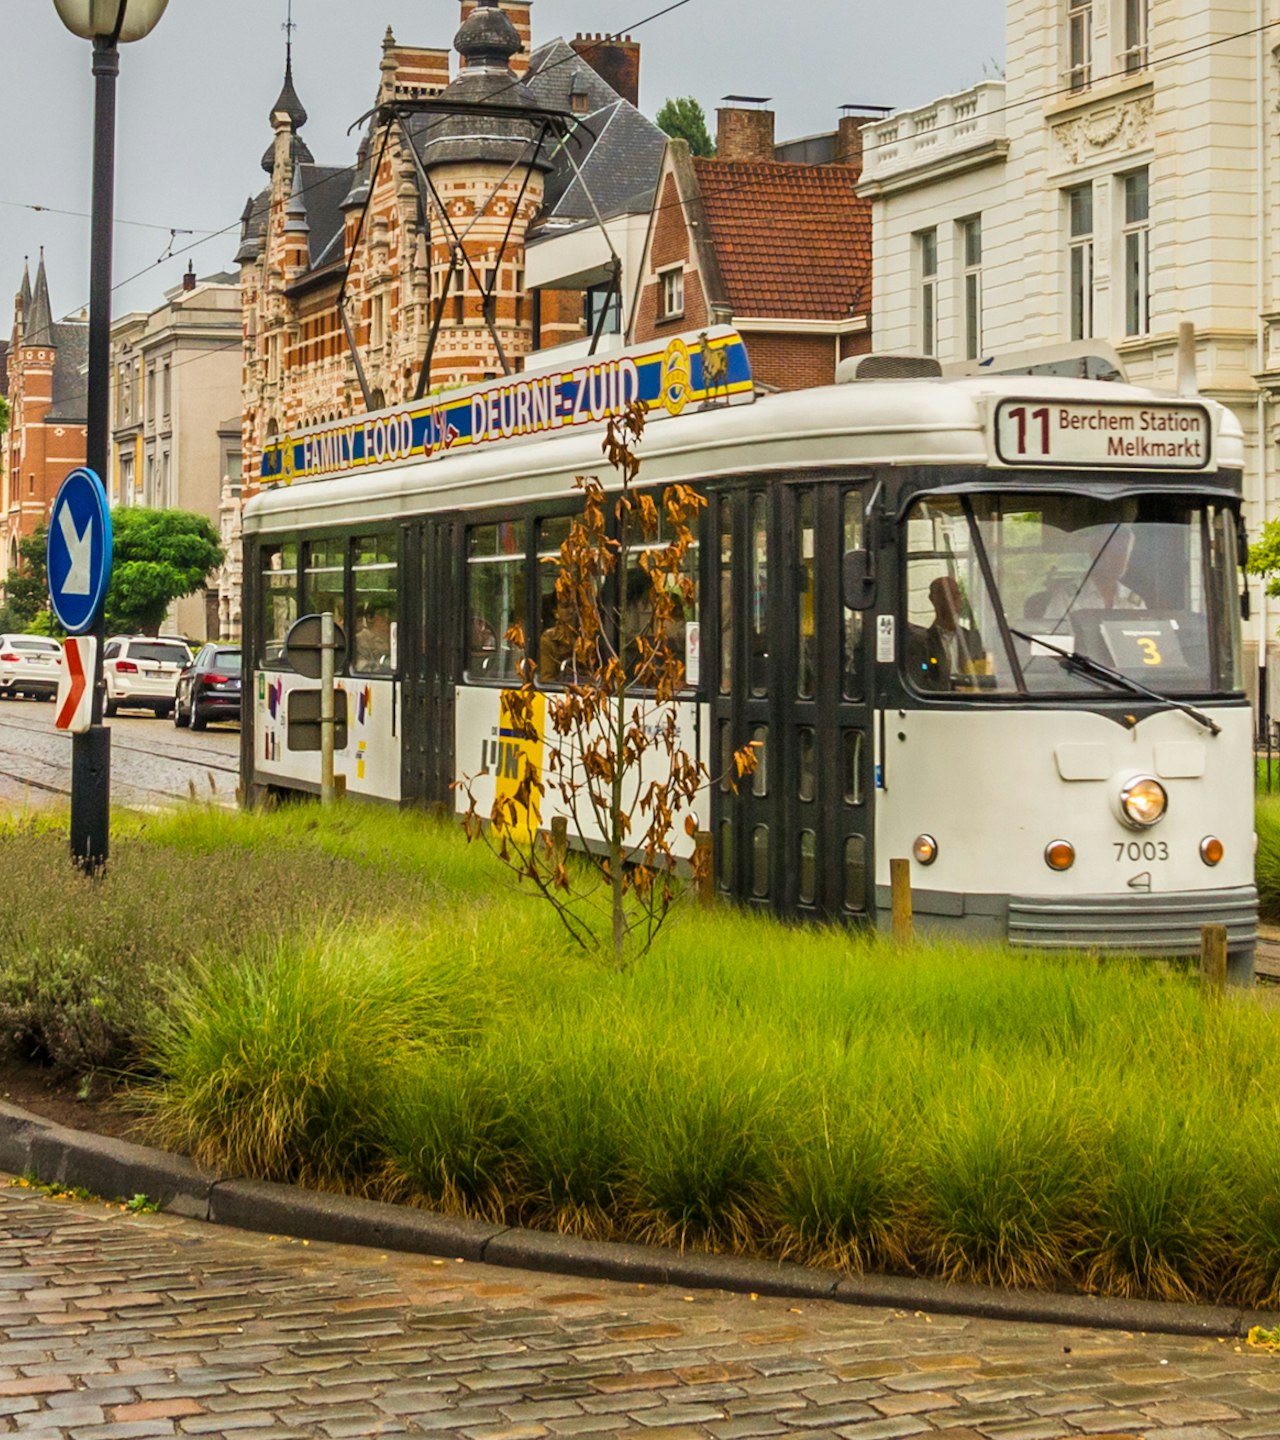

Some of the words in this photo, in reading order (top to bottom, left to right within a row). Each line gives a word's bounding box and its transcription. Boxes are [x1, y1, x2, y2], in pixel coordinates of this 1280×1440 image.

[303, 424, 356, 477] FAMILY
[363, 412, 413, 464] FOOD
[470, 357, 639, 445] DEURNE-ZUID
[1058, 409, 1135, 431] Berchem
[1139, 411, 1201, 432] Station
[1008, 407, 1050, 455] 11
[1107, 436, 1202, 458] Melkmarkt
[1136, 637, 1162, 665] 3
[1112, 840, 1170, 862] 7003
